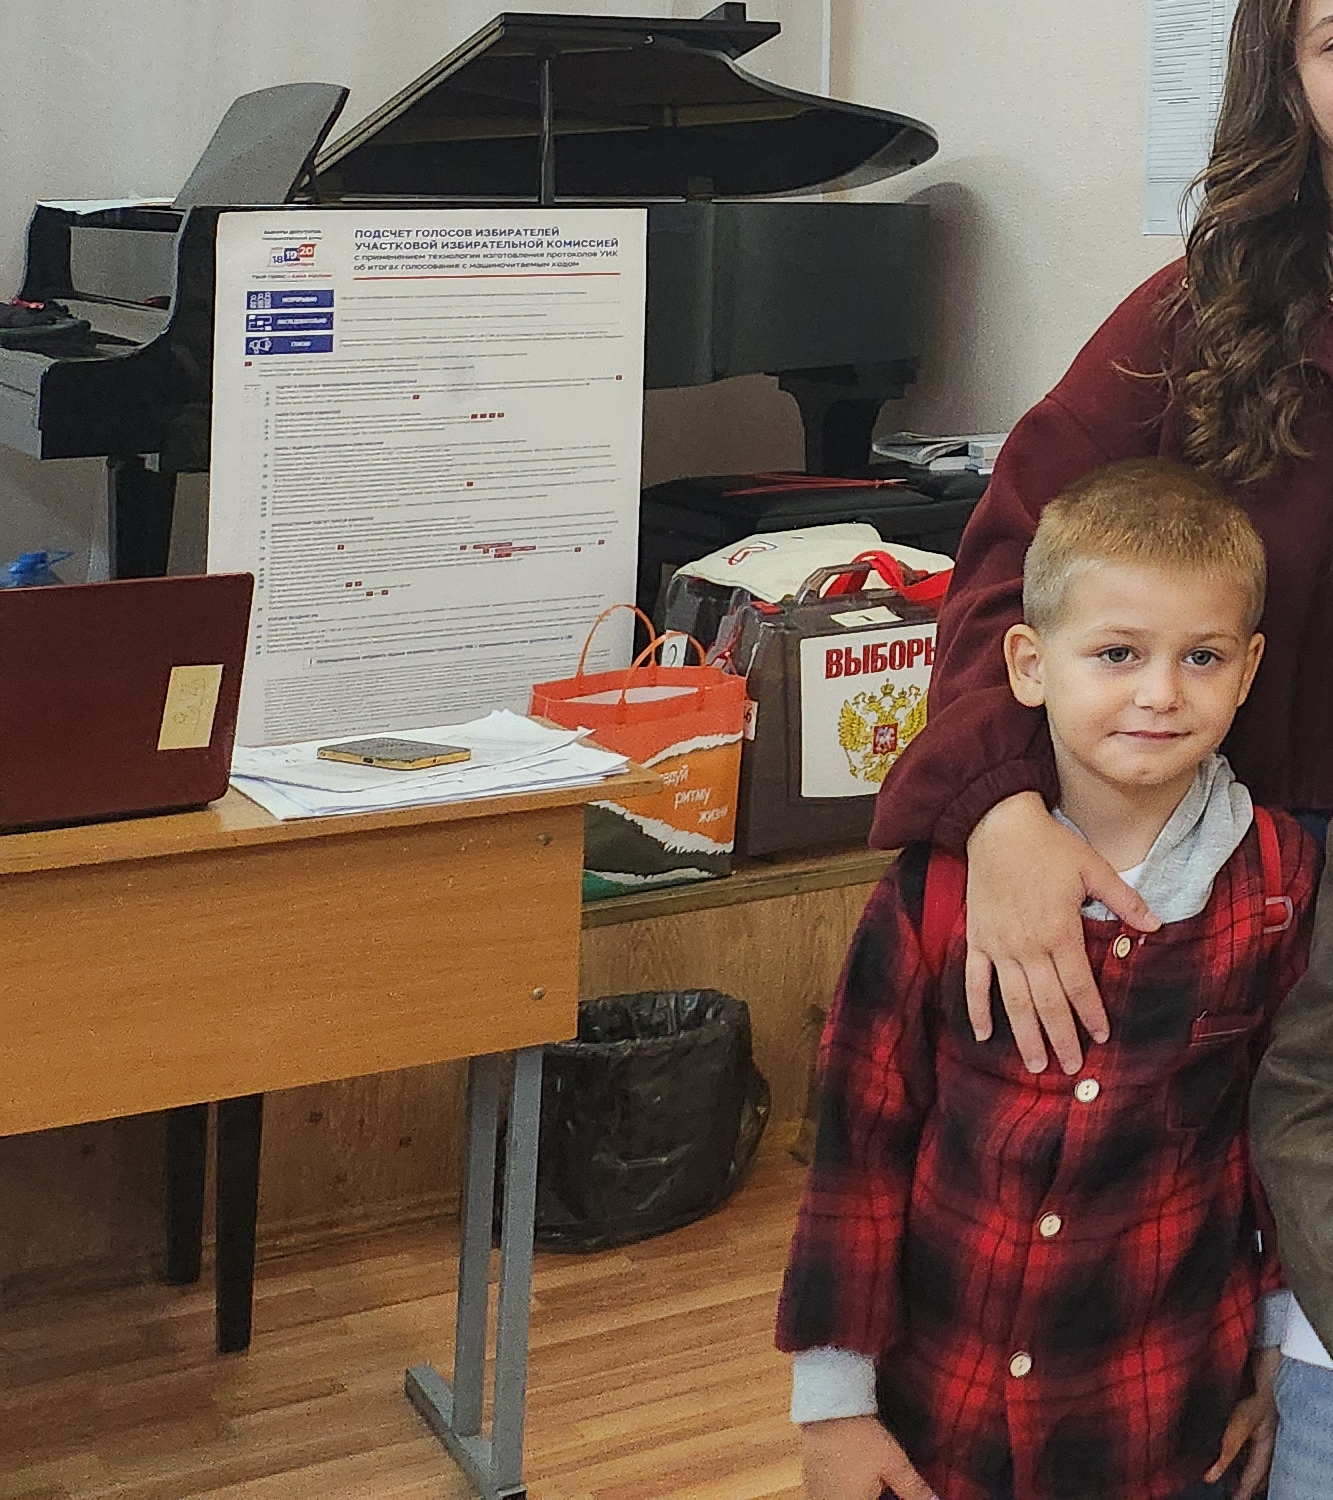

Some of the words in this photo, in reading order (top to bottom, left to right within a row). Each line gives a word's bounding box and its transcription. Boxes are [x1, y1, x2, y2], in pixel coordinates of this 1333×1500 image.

[354, 229, 412, 239] ПОДСЧЕТ
[415, 229, 473, 238] ГОЛОСОВ
[475, 226, 560, 238] ИЗБИРАТЕЛЕЙ
[354, 239, 438, 251] УЧАСТКОВОЙ
[441, 238, 544, 250] ИЗБИРАТЕЛЬНОЙ
[546, 237, 619, 248] КОМИССИЕЙ
[299, 246, 314, 256] 20
[600, 249, 619, 257] УИК
